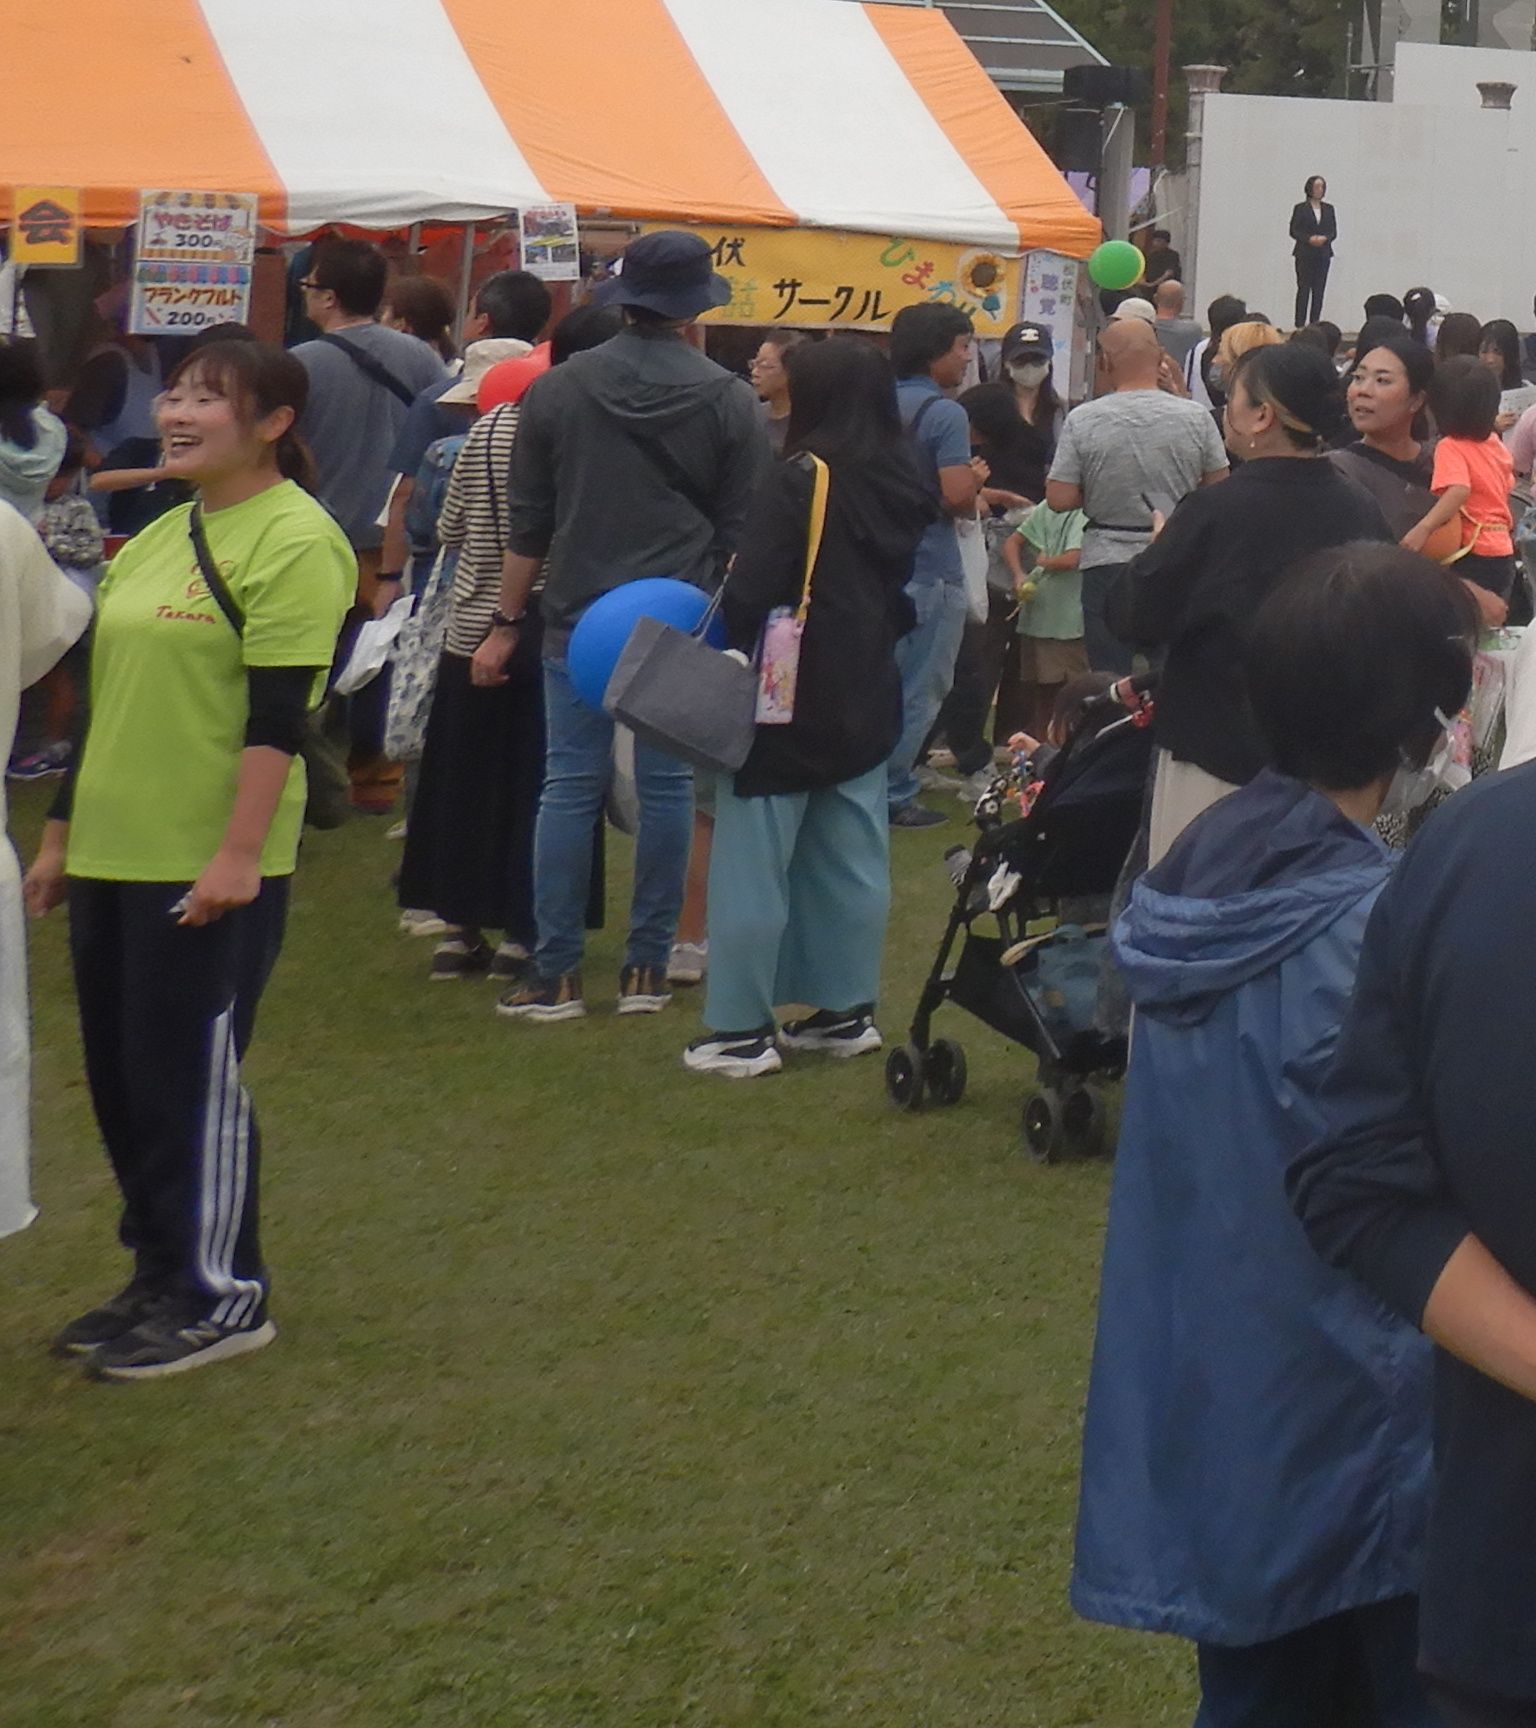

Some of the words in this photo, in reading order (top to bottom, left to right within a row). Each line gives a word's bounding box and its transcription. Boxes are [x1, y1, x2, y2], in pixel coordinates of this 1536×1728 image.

[19, 200, 71, 245] 会
[155, 212, 232, 232] やきそば
[145, 287, 242, 306] フランクフルト
